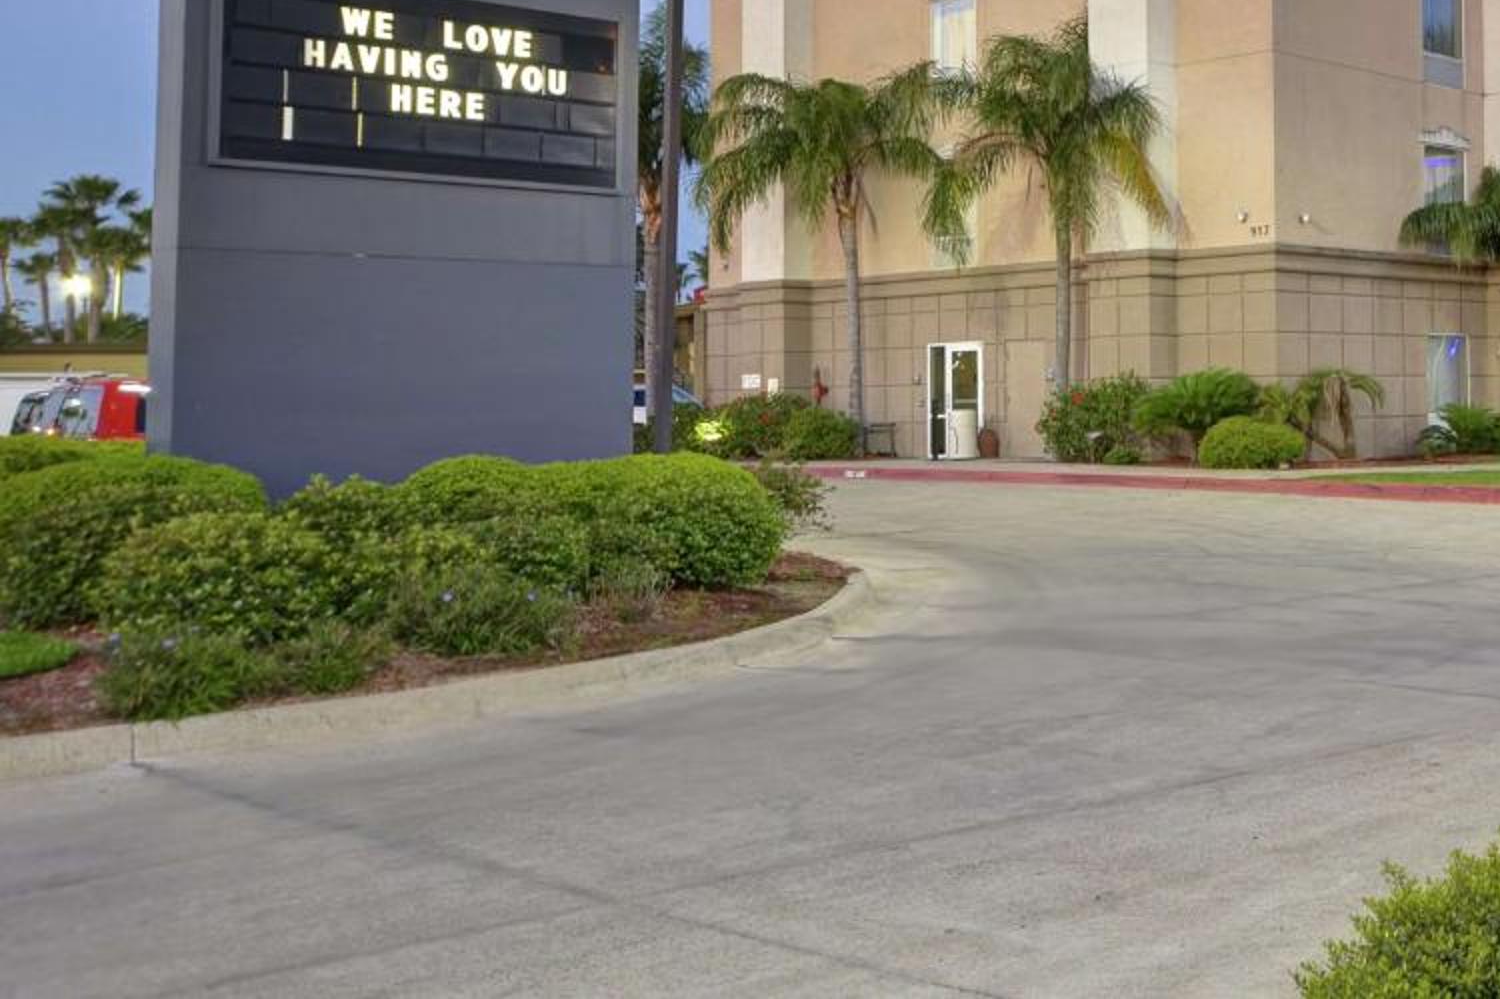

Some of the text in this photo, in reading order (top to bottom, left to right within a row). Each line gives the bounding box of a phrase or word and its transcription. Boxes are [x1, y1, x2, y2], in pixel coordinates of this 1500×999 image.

[340, 6, 533, 58] WE LOVE
[303, 38, 568, 96] HAVING YOU
[390, 84, 486, 121] HERE
